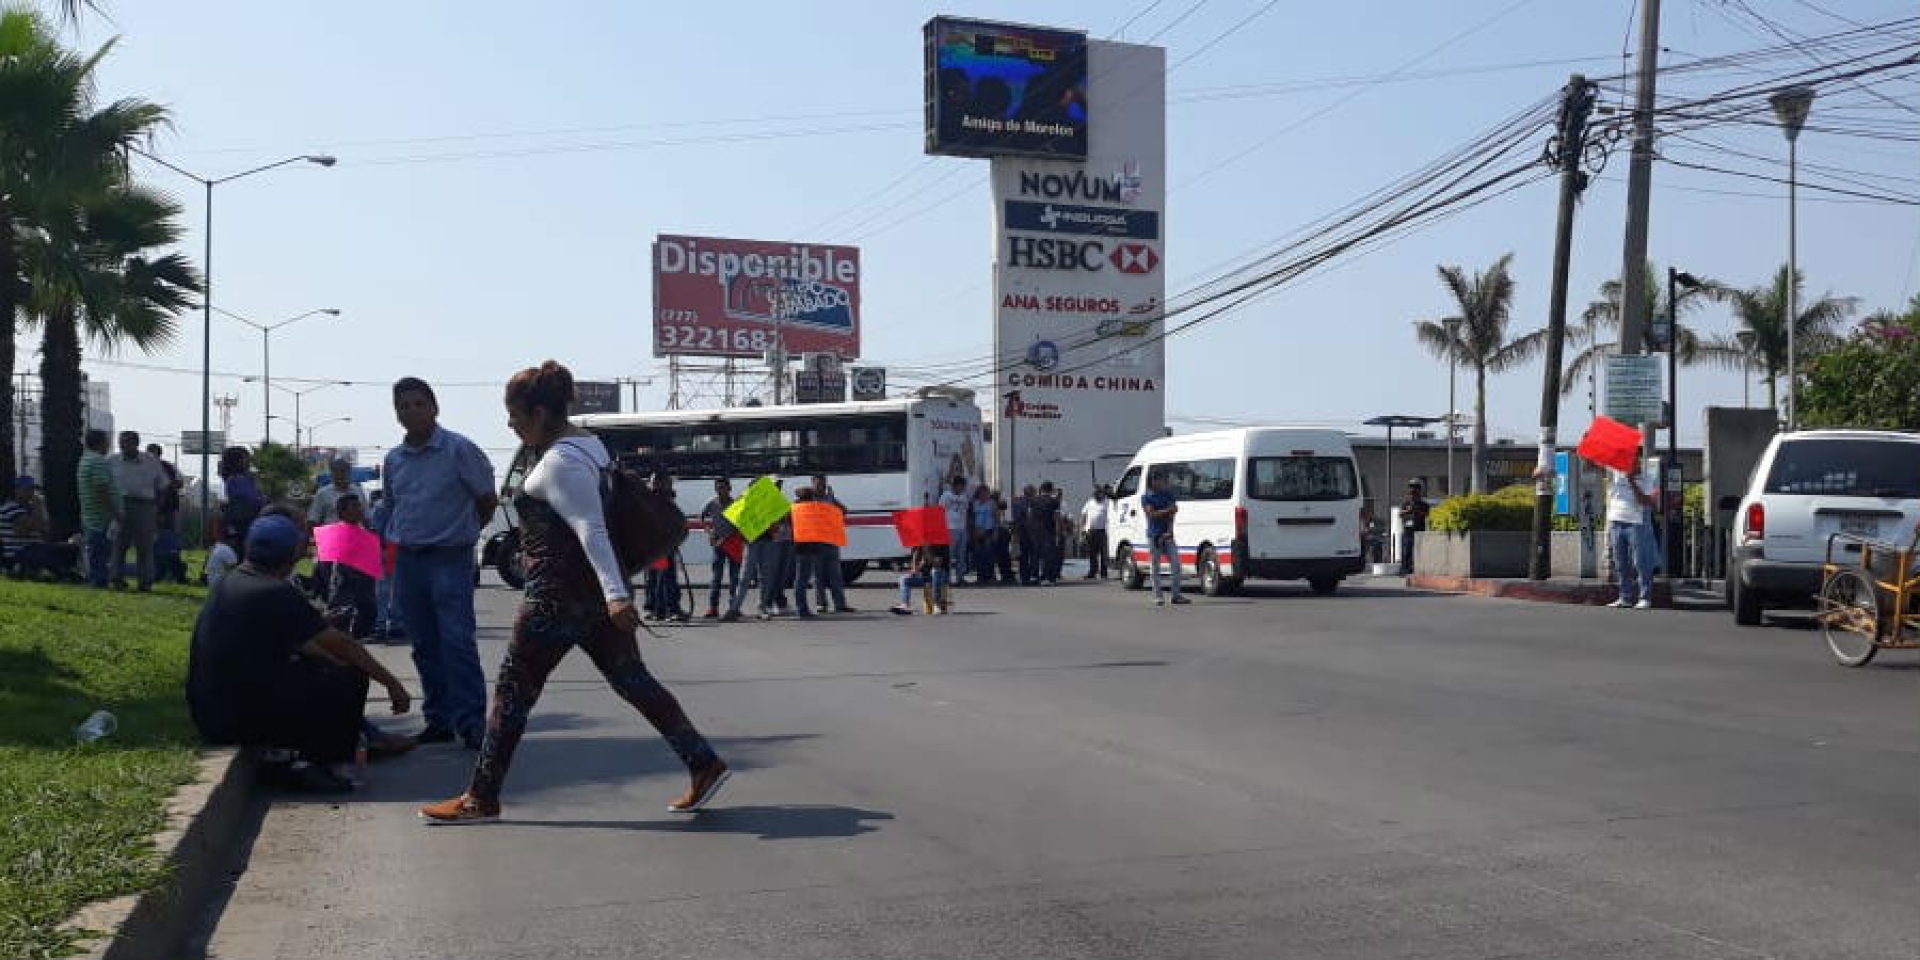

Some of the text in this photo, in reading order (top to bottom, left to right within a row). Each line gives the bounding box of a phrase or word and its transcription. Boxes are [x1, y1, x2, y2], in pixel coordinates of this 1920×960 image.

[1021, 170, 1121, 203] NOVUM
[660, 240, 857, 285] Disponible
[1007, 236, 1104, 271] HSBC
[1002, 294, 1121, 312] ANA SEGUROS
[1008, 373, 1155, 391] COMIDA CHINA
